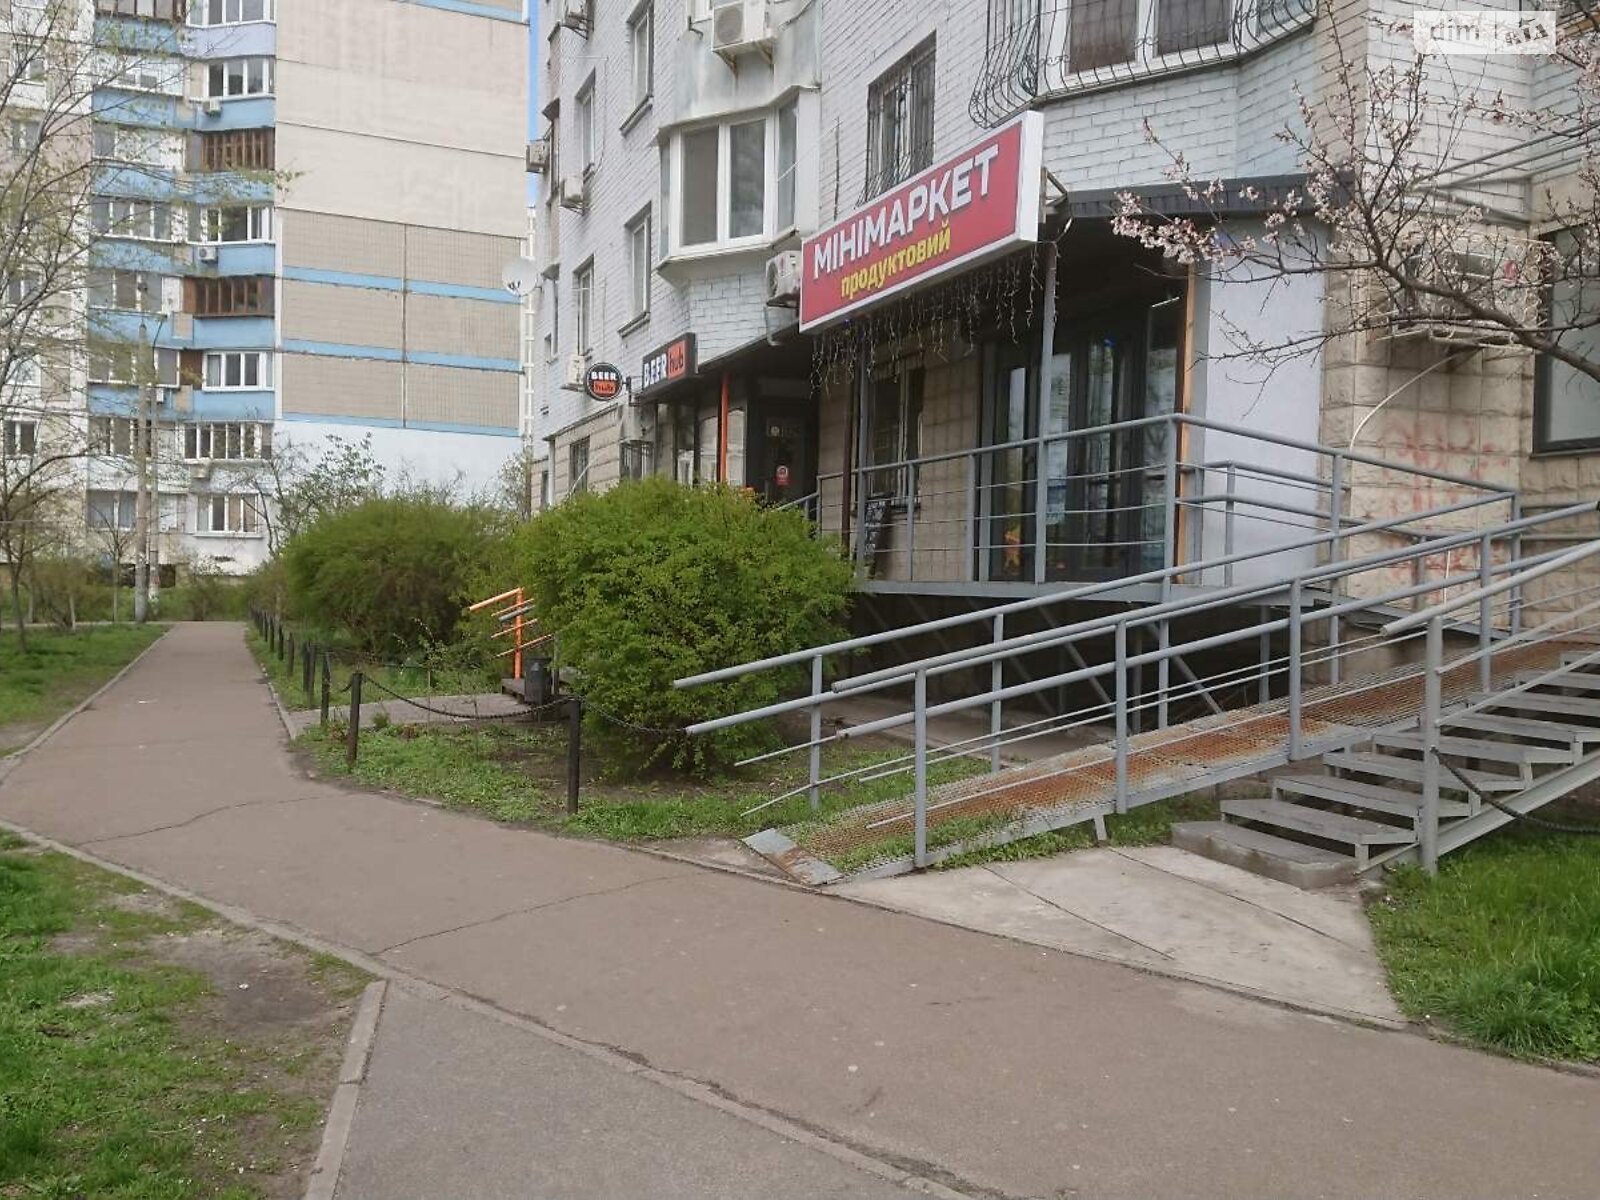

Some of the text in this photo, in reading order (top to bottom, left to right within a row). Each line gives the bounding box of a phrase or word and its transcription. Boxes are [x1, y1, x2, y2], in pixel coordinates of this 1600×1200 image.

[813, 144, 999, 280] МІНІМАРКЕТ
[841, 220, 951, 300] продуктовий
[643, 353, 667, 388] BEER
